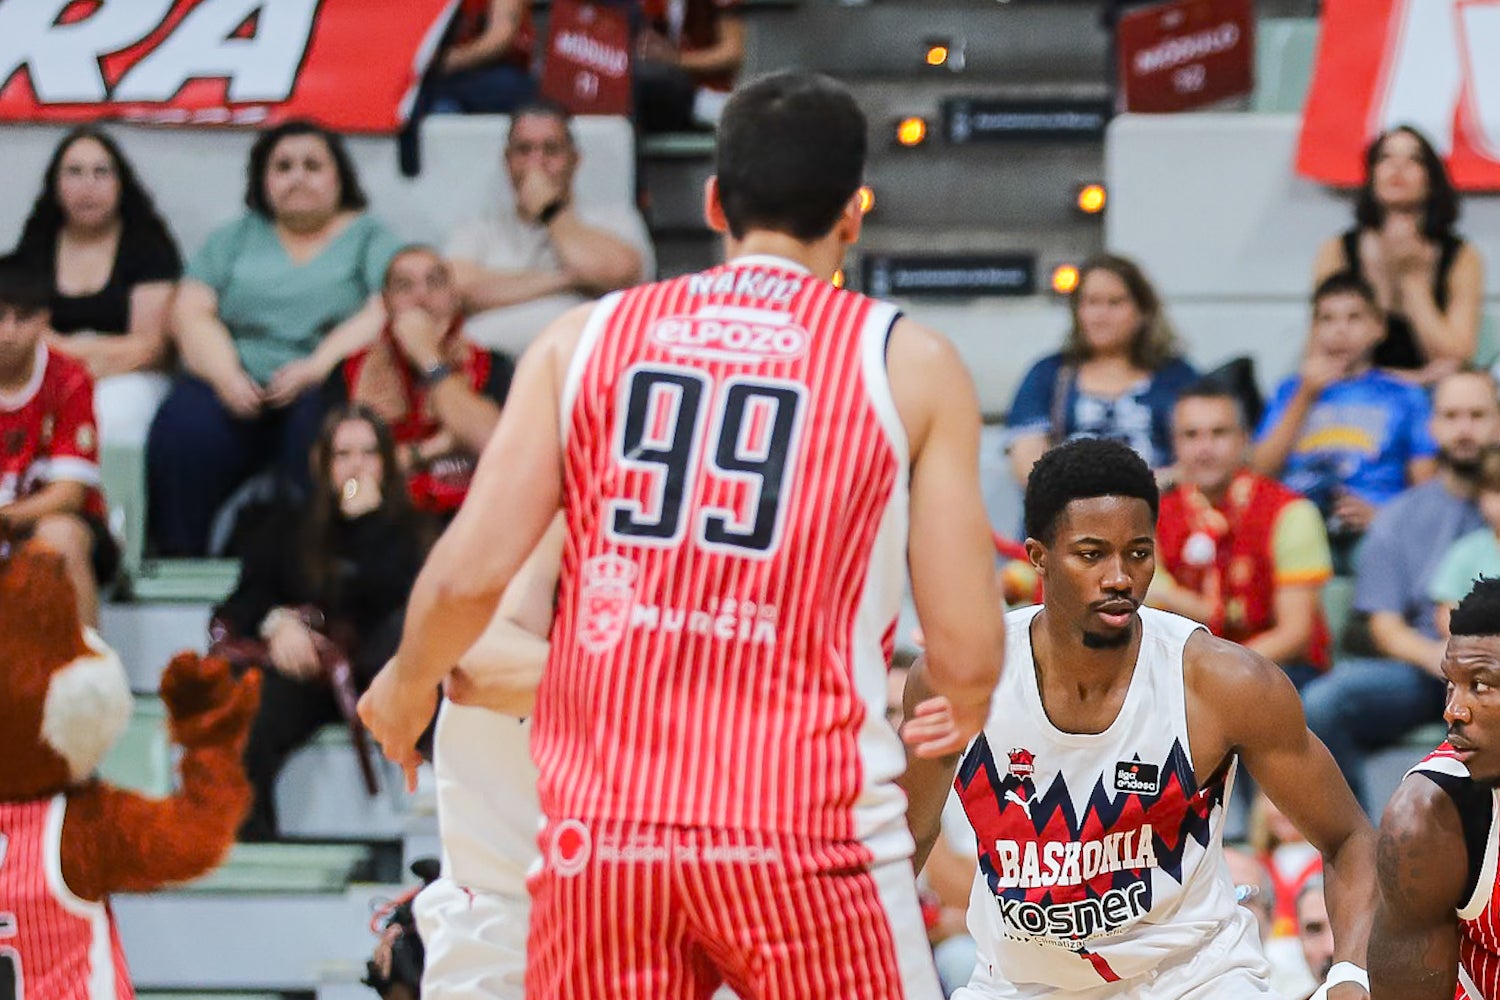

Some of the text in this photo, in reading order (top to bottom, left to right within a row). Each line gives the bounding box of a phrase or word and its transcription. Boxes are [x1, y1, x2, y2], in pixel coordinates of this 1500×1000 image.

[605, 361, 808, 559] 99
[995, 824, 1158, 888] BASKONIA
[996, 881, 1147, 935] kosner
